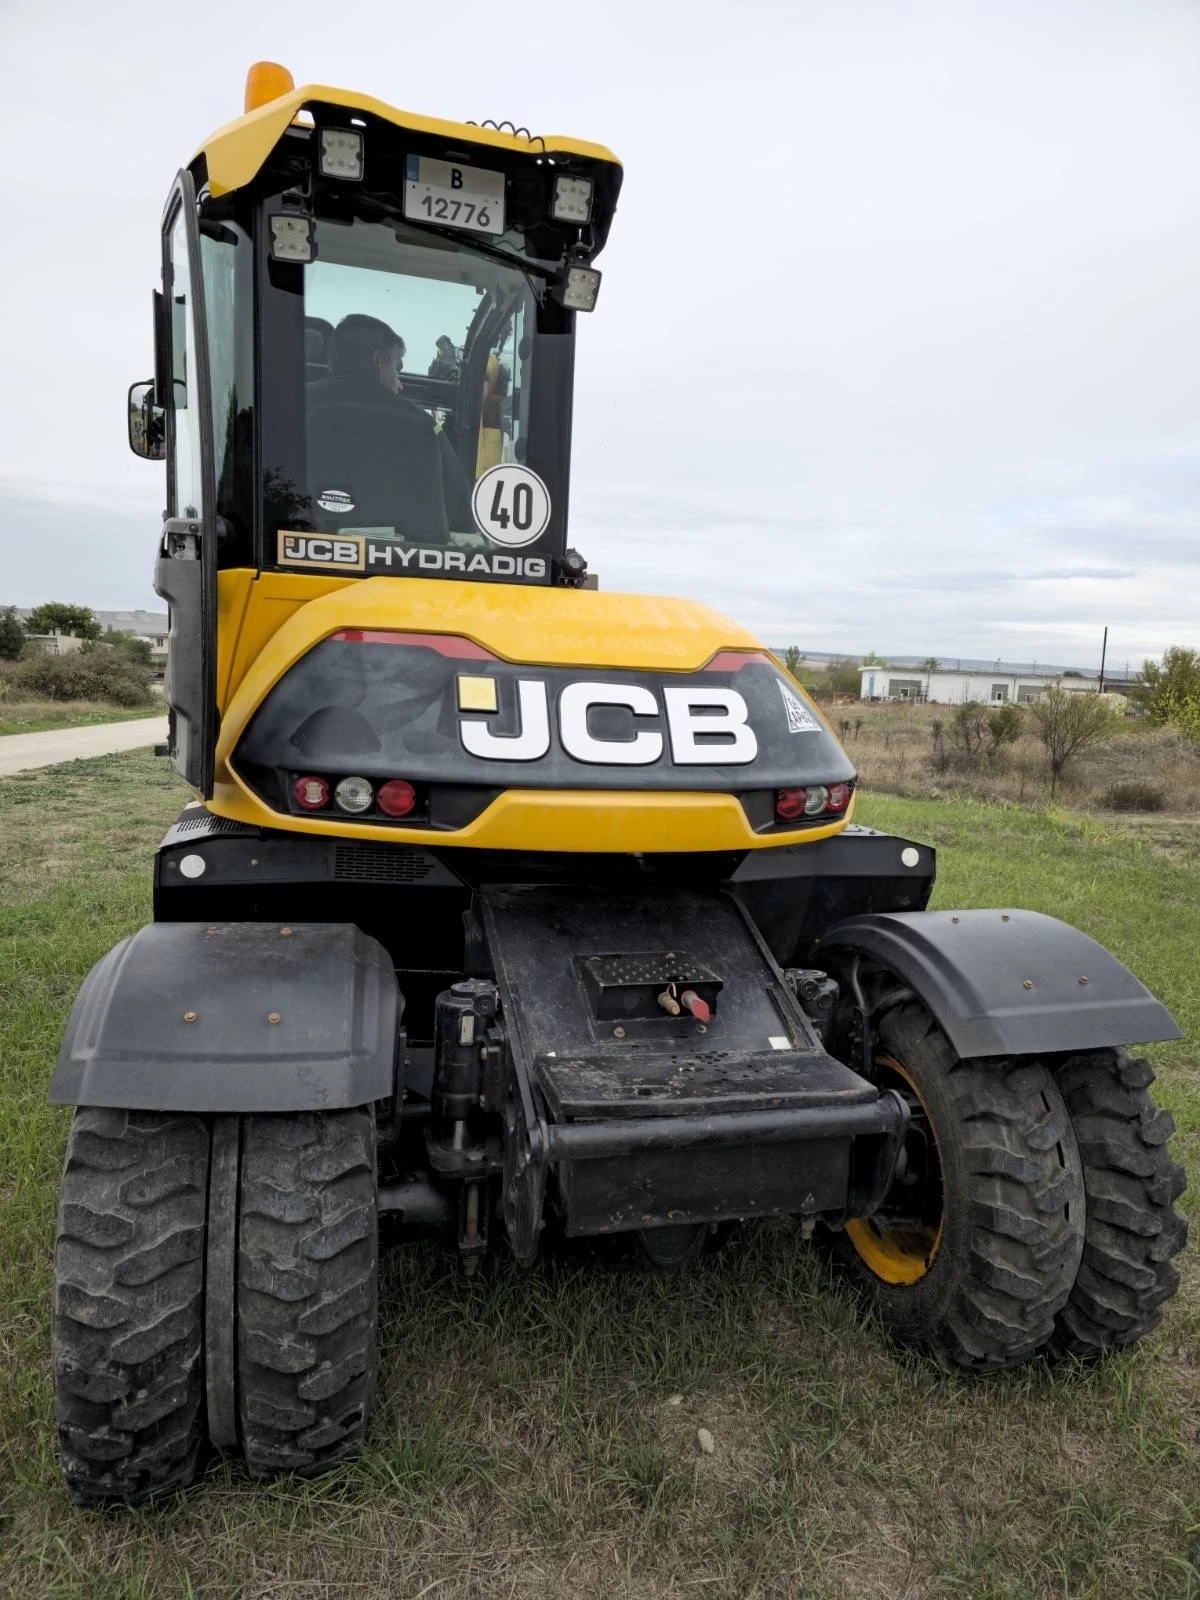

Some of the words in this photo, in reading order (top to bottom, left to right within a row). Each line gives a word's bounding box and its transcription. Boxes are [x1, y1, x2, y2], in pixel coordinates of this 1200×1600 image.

[451, 168, 463, 189] B
[422, 196, 490, 227] 12776
[490, 480, 533, 531] 40
[285, 537, 358, 563] JCB
[368, 544, 546, 577] HYDRADIG
[459, 677, 758, 765] JCB
